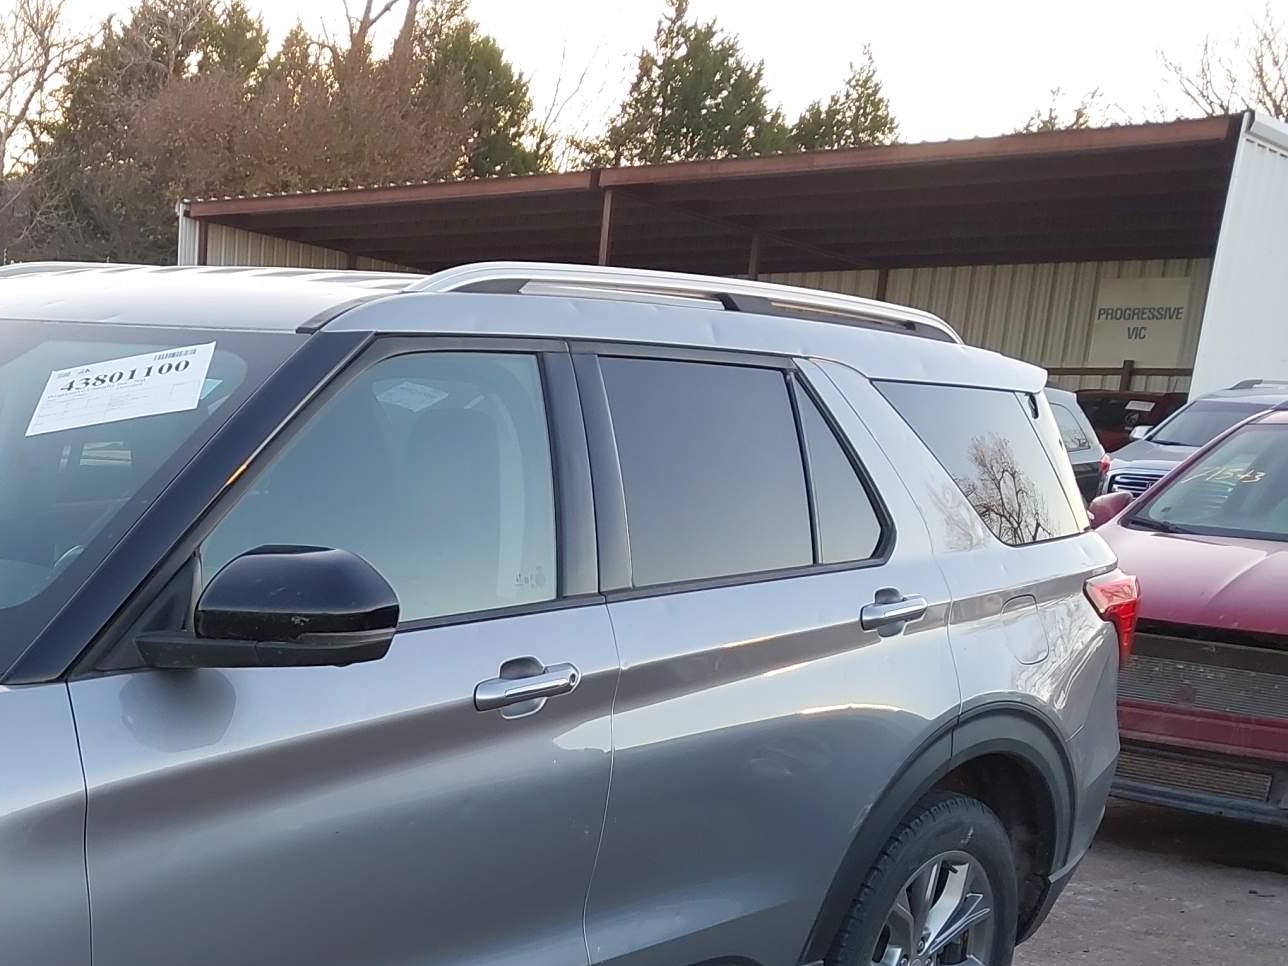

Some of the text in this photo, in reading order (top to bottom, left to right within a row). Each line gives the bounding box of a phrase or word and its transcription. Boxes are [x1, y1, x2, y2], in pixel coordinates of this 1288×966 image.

[1097, 306, 1184, 321] PROGRESSIVE
[1127, 326, 1147, 340] VIC
[60, 359, 190, 392] 43801100
